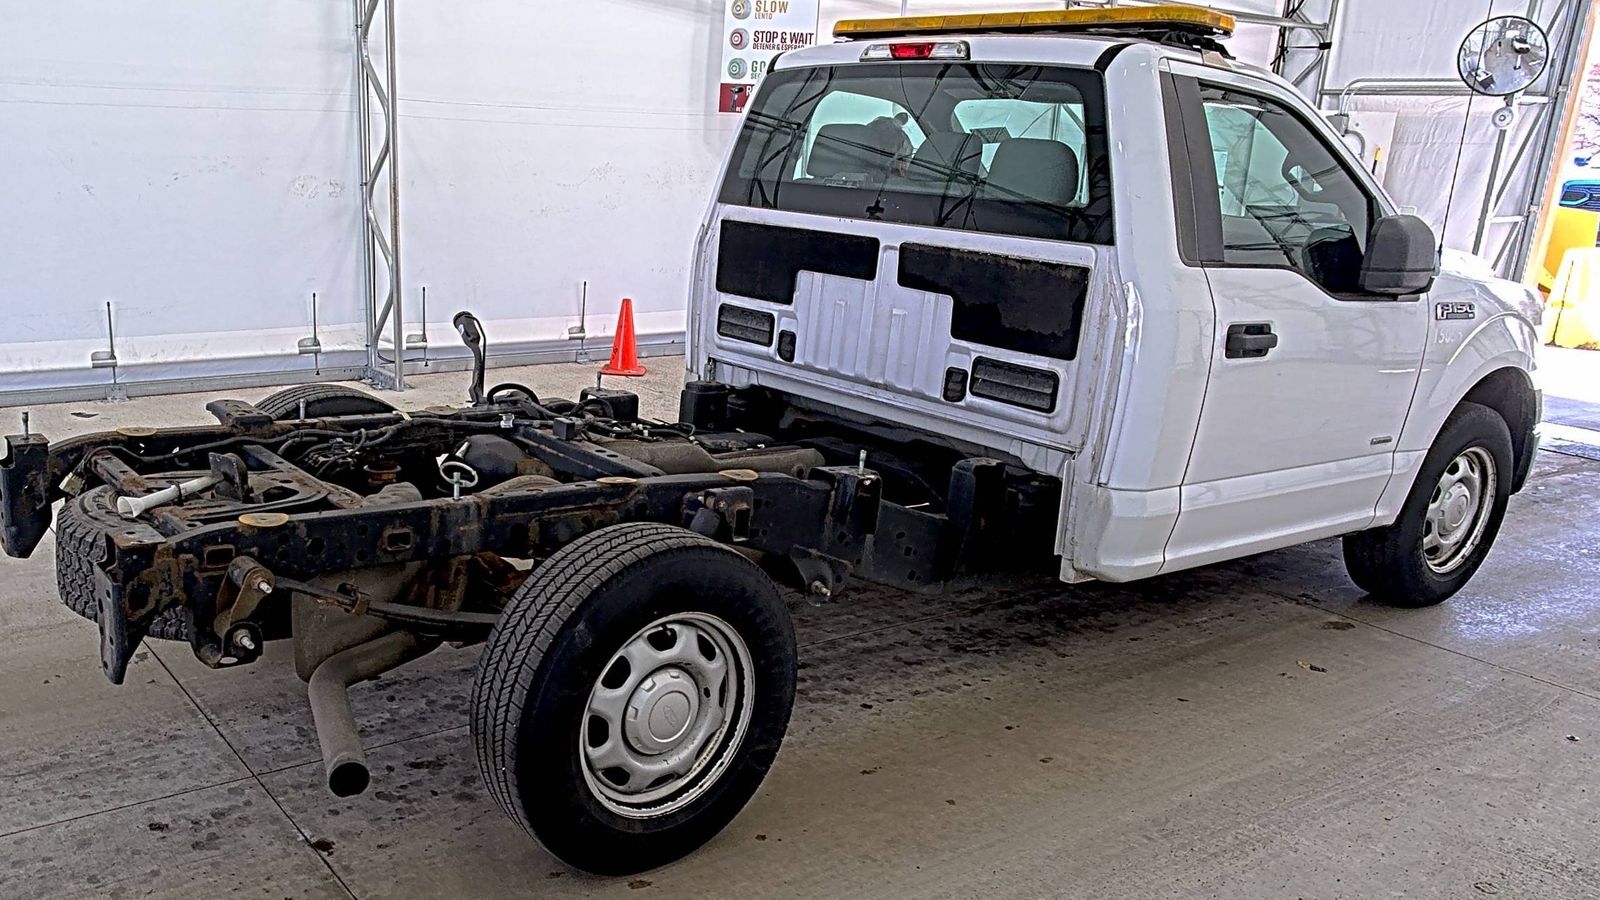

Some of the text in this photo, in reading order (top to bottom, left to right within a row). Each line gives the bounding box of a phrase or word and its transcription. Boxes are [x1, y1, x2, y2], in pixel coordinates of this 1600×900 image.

[755, 0, 788, 13] SLOW
[753, 30, 815, 45] STOP & WAIT
[752, 42, 776, 50] DETENER
